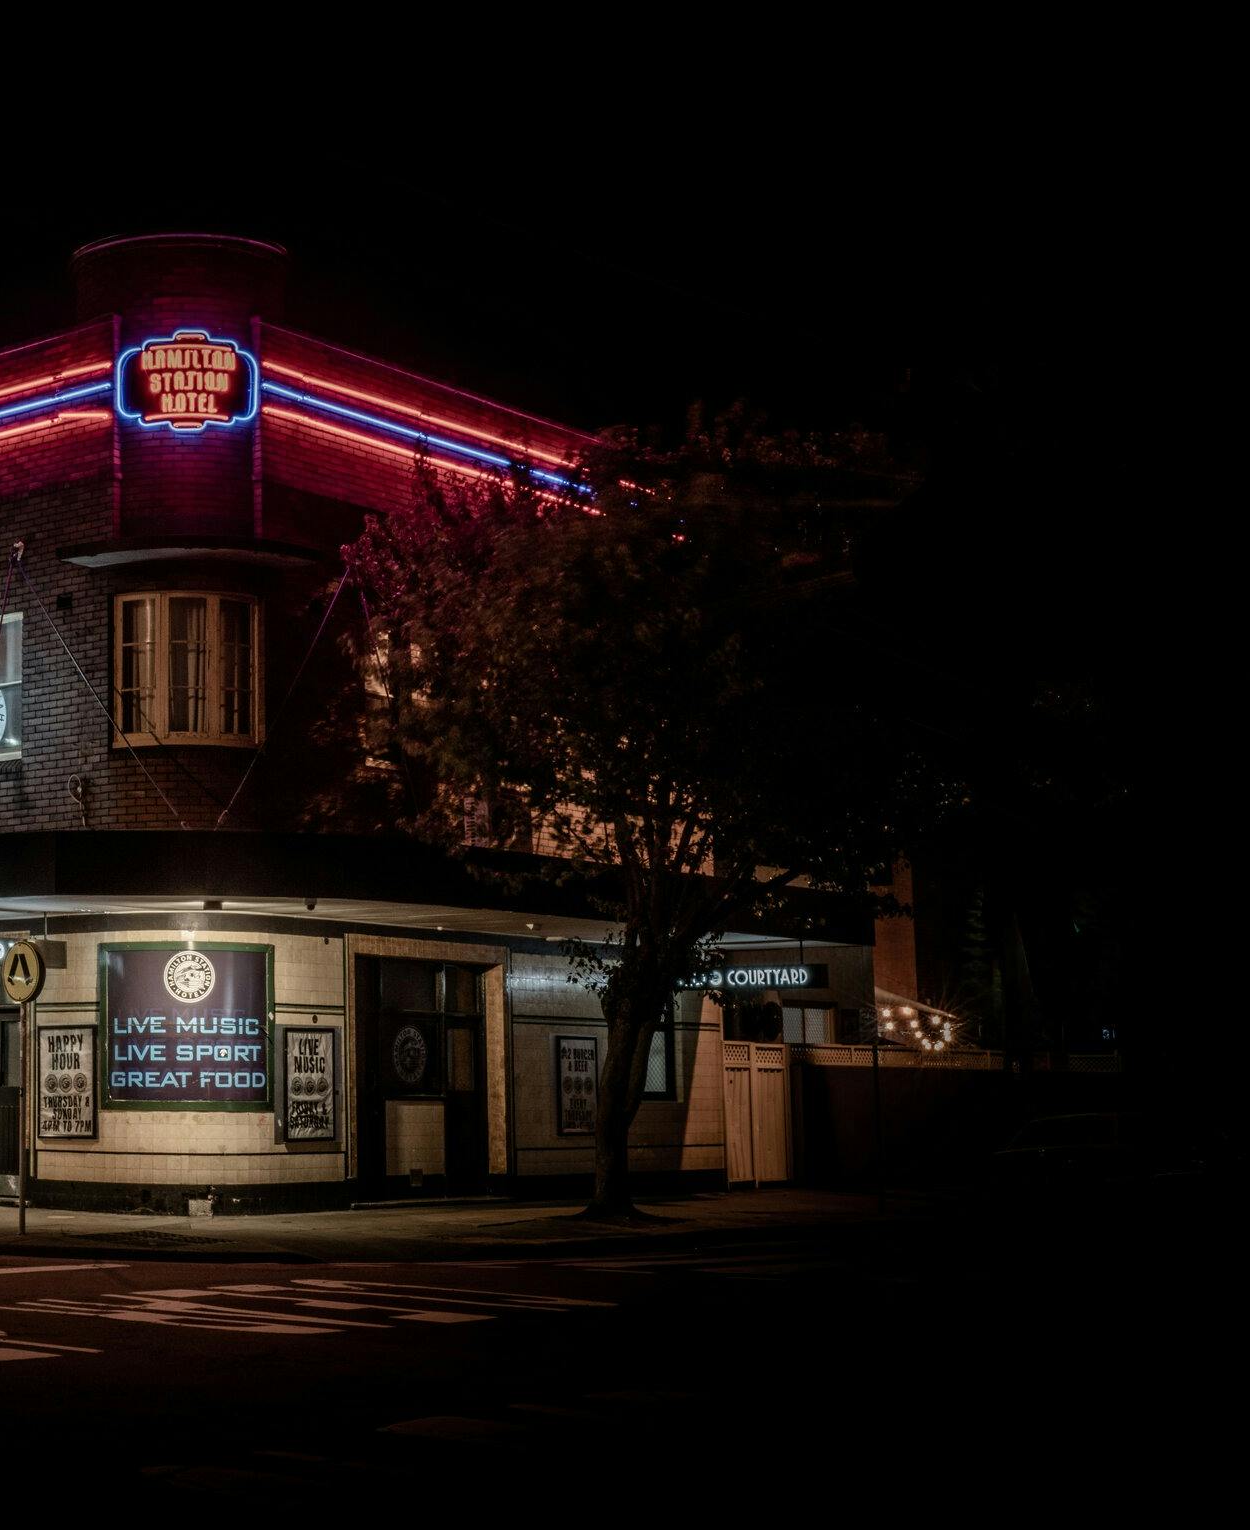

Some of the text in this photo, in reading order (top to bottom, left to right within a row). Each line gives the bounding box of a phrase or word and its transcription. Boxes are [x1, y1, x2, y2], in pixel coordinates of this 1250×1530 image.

[141, 349, 237, 370] HAMILTON
[150, 371, 229, 393] STATION
[161, 393, 218, 413] HOTEL
[168, 955, 211, 987] HAMILTON STATION
[727, 968, 808, 985] COURTYARD
[175, 987, 206, 999] HOTEL
[114, 1016, 260, 1035] LIVE MUSIC
[48, 1034, 83, 1053] HAPPY
[298, 1039, 319, 1056] LIVE
[52, 1053, 80, 1070] HOUR
[114, 1044, 262, 1062] LIVE SPORT
[294, 1056, 326, 1074] MUSIC
[574, 1061, 588, 1072] BEER
[111, 1071, 266, 1088] GREAT FOOD
[43, 1095, 82, 1108] THURSDAY
[52, 1108, 82, 1120] SUNDAY
[43, 1120, 92, 1133] 4PM TO 7PM
